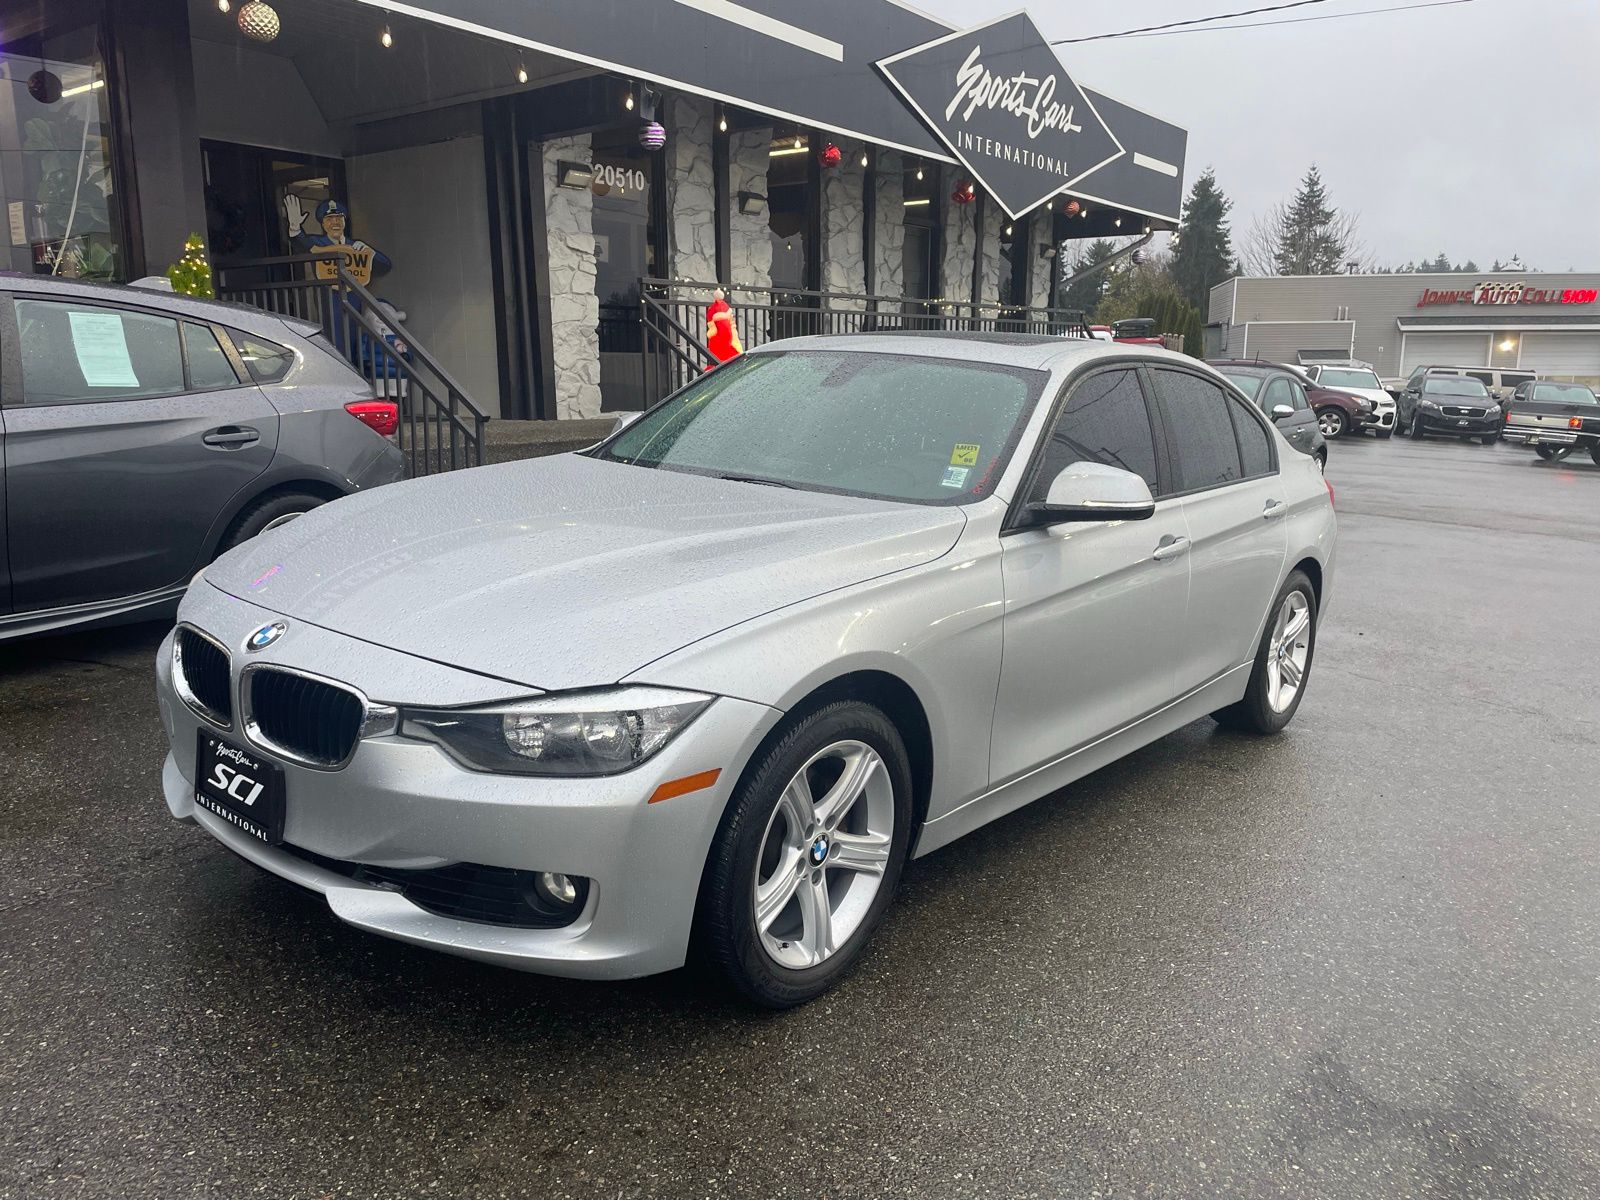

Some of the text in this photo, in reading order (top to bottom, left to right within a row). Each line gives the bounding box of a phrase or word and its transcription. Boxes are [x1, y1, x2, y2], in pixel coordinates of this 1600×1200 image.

[945, 45, 1082, 139] Sports Cars
[958, 130, 1069, 177] INTERNATIONAL
[594, 163, 645, 191] 20510
[323, 253, 368, 268] OW
[327, 268, 366, 277] SCOL
[207, 763, 265, 806] SCI
[196, 793, 268, 842] INTERNATIONAL
